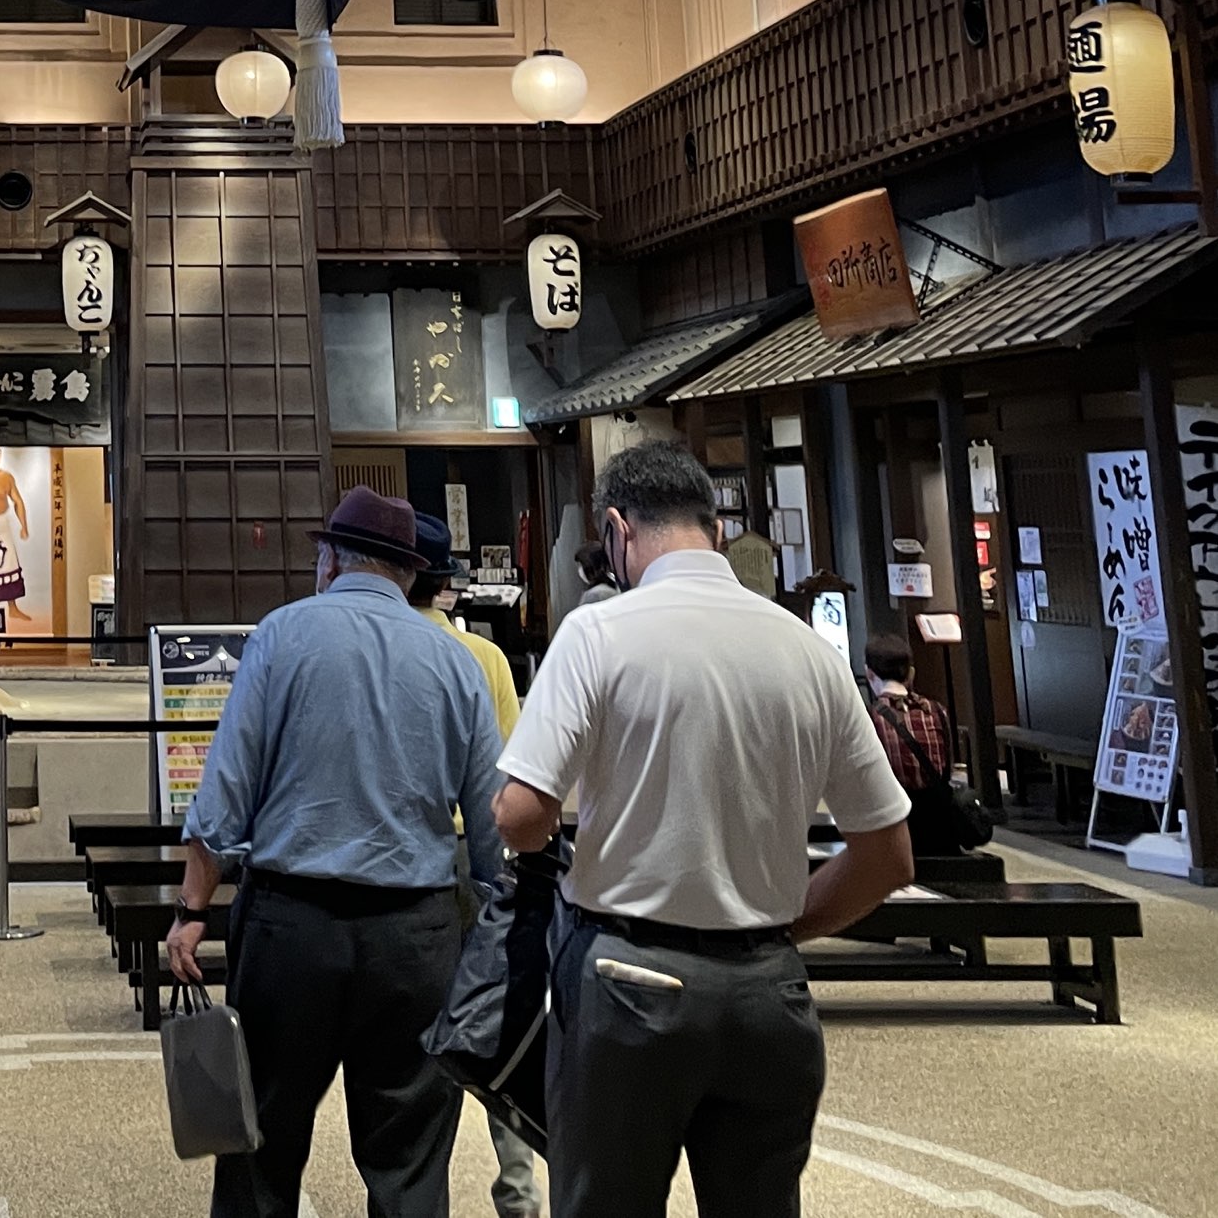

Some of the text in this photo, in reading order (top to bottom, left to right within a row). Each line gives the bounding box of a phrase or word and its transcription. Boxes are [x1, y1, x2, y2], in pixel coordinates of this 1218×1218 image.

[542, 245, 580, 316] そば
[827, 236, 898, 290] 田所商店
[1112, 454, 1153, 572] 味噌
